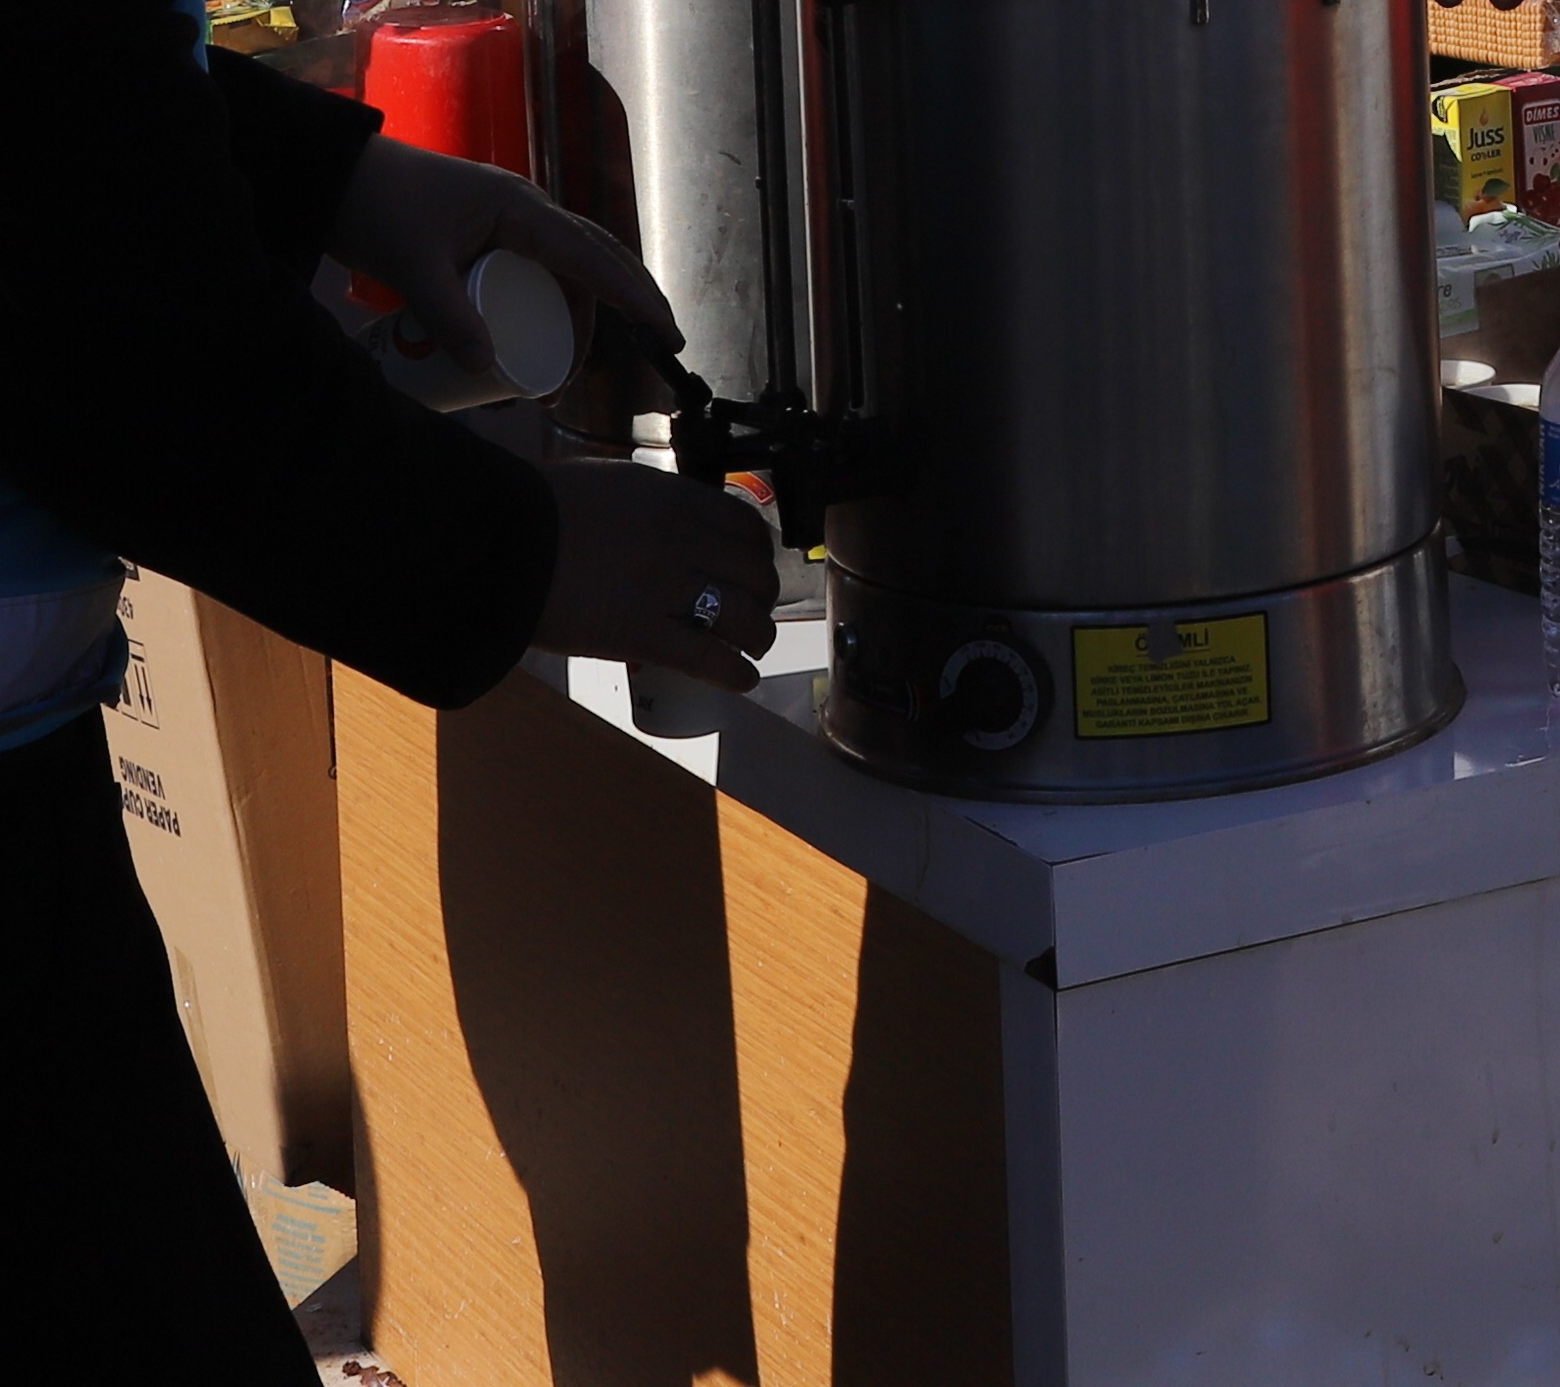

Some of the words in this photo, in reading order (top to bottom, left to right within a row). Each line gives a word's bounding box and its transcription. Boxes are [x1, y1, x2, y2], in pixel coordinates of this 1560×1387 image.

[1526, 106, 1559, 122] DİMES
[1467, 126, 1505, 150] Juss
[1135, 627, 1209, 652] ÖMLİ
[118, 756, 166, 800] VENDING
[123, 787, 145, 820] CUP
[145, 798, 182, 838] PAPER
